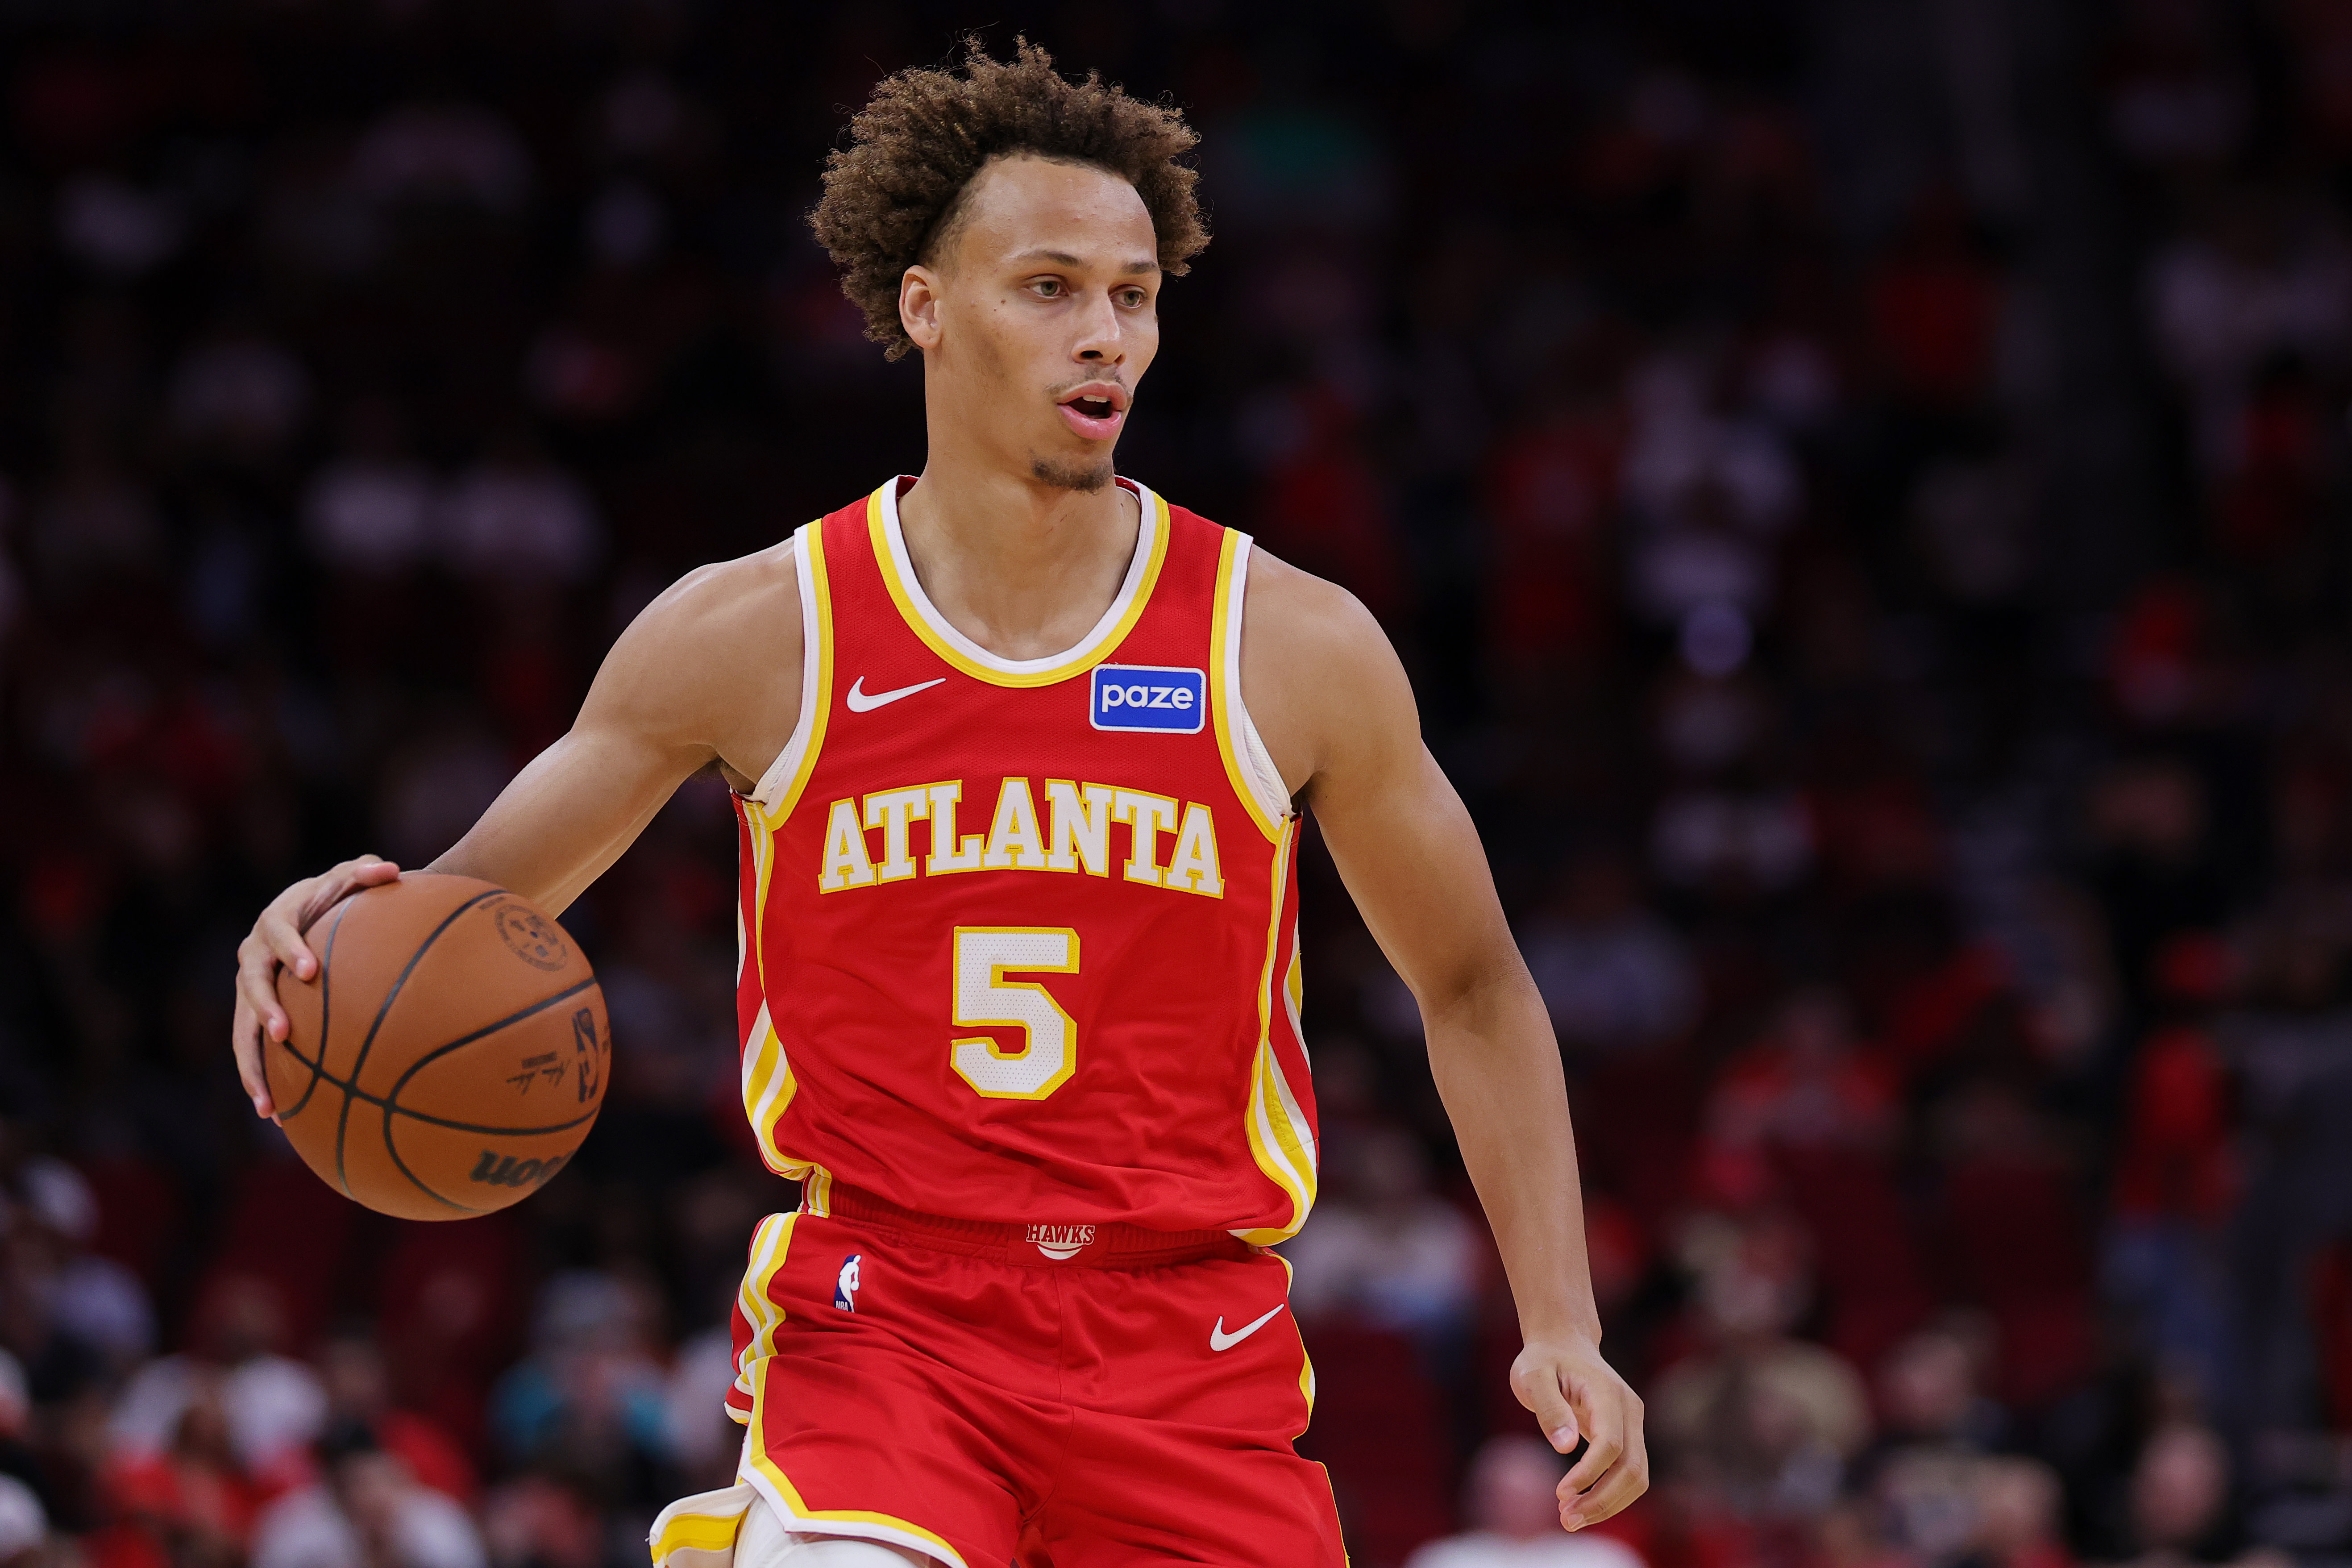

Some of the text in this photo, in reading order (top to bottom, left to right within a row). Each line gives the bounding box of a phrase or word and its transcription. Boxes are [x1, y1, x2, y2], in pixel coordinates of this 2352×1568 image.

[1101, 684, 1193, 713] paze
[818, 776, 1225, 900] ATLANTA
[950, 926, 1080, 1101] 5
[1027, 1224, 1095, 1244] HAWKS
[835, 1300, 848, 1311] NBA
